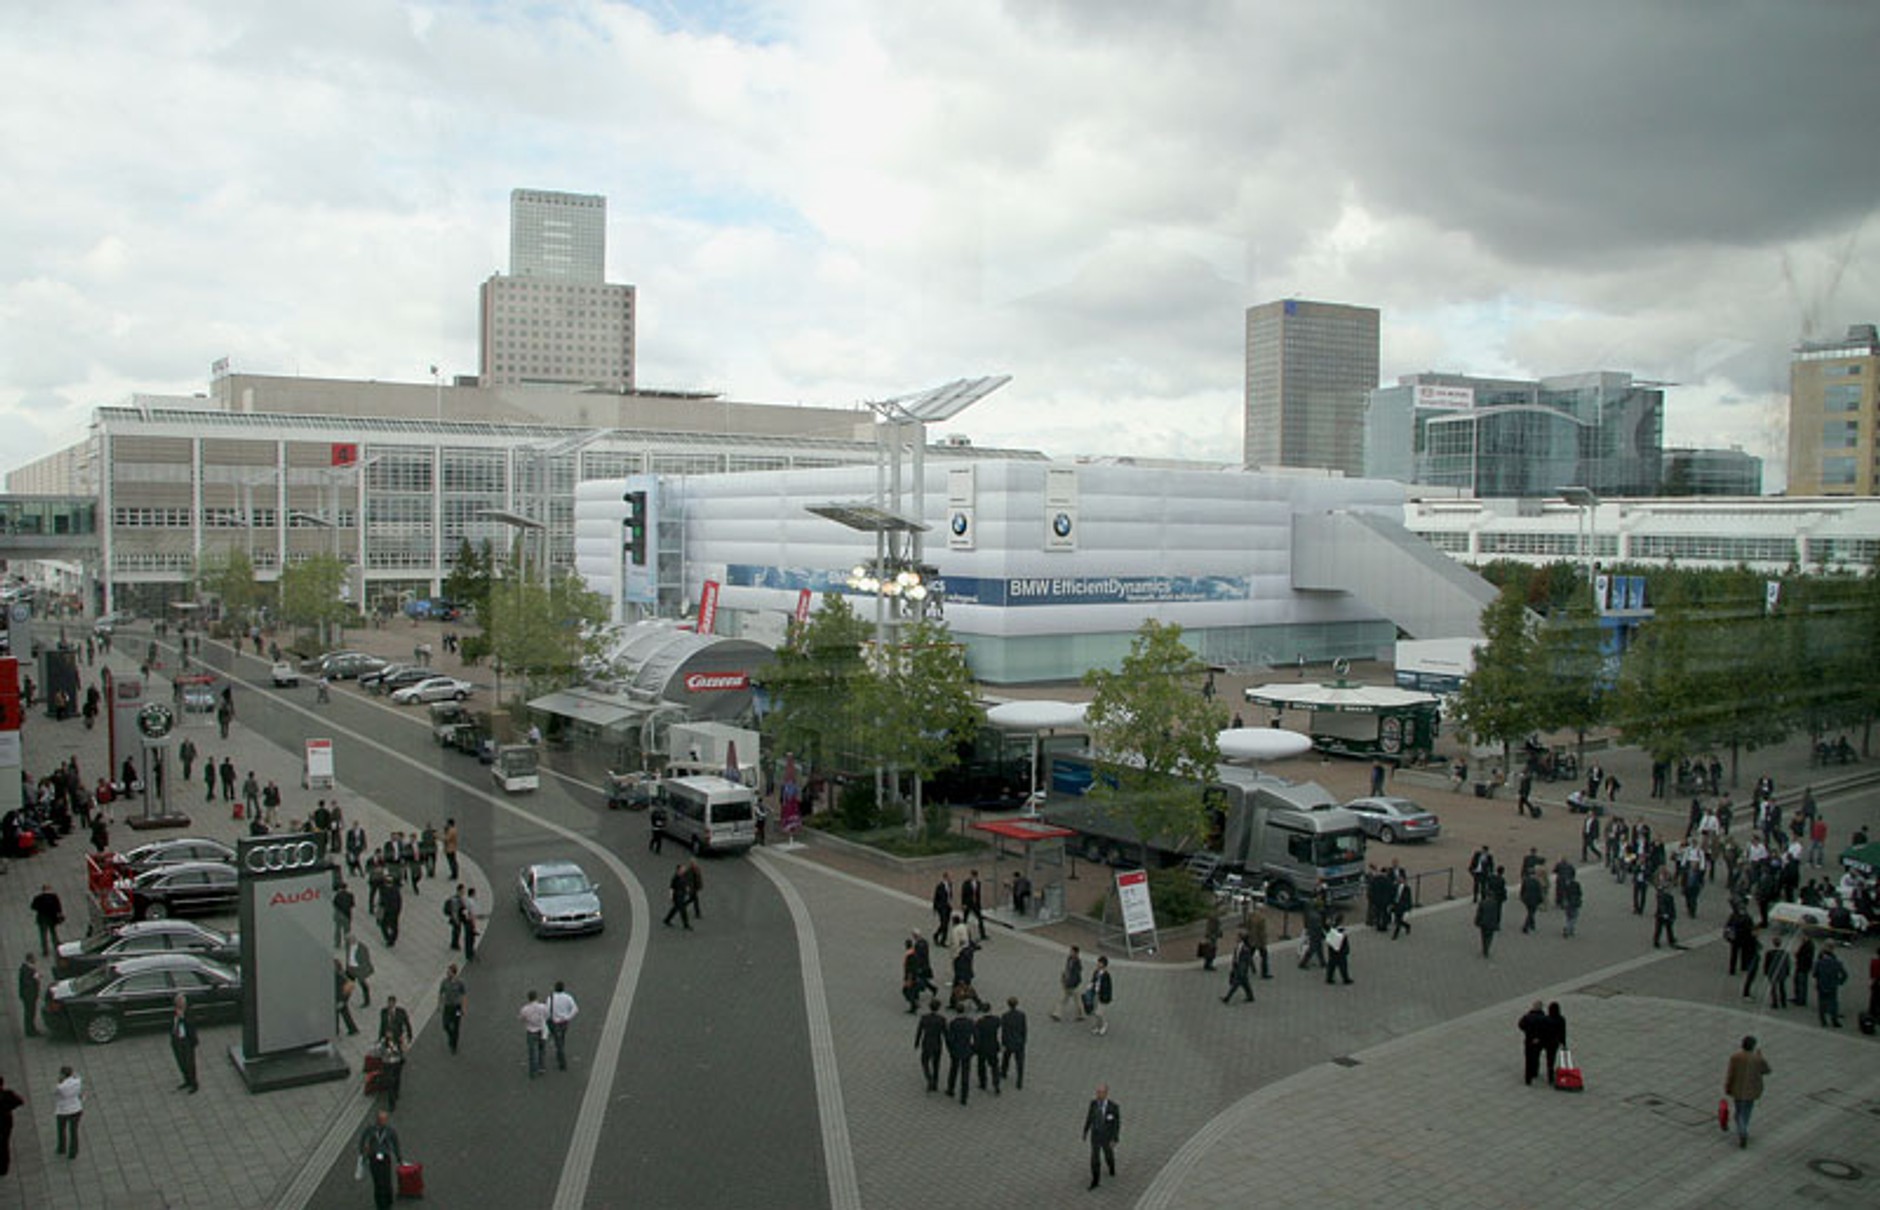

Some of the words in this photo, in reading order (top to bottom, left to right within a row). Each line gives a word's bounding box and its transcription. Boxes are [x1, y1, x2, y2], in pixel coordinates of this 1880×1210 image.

[1010, 579, 1050, 596] BMW
[1052, 576, 1171, 597] EfficientDynamics
[269, 888, 321, 907] Audi
